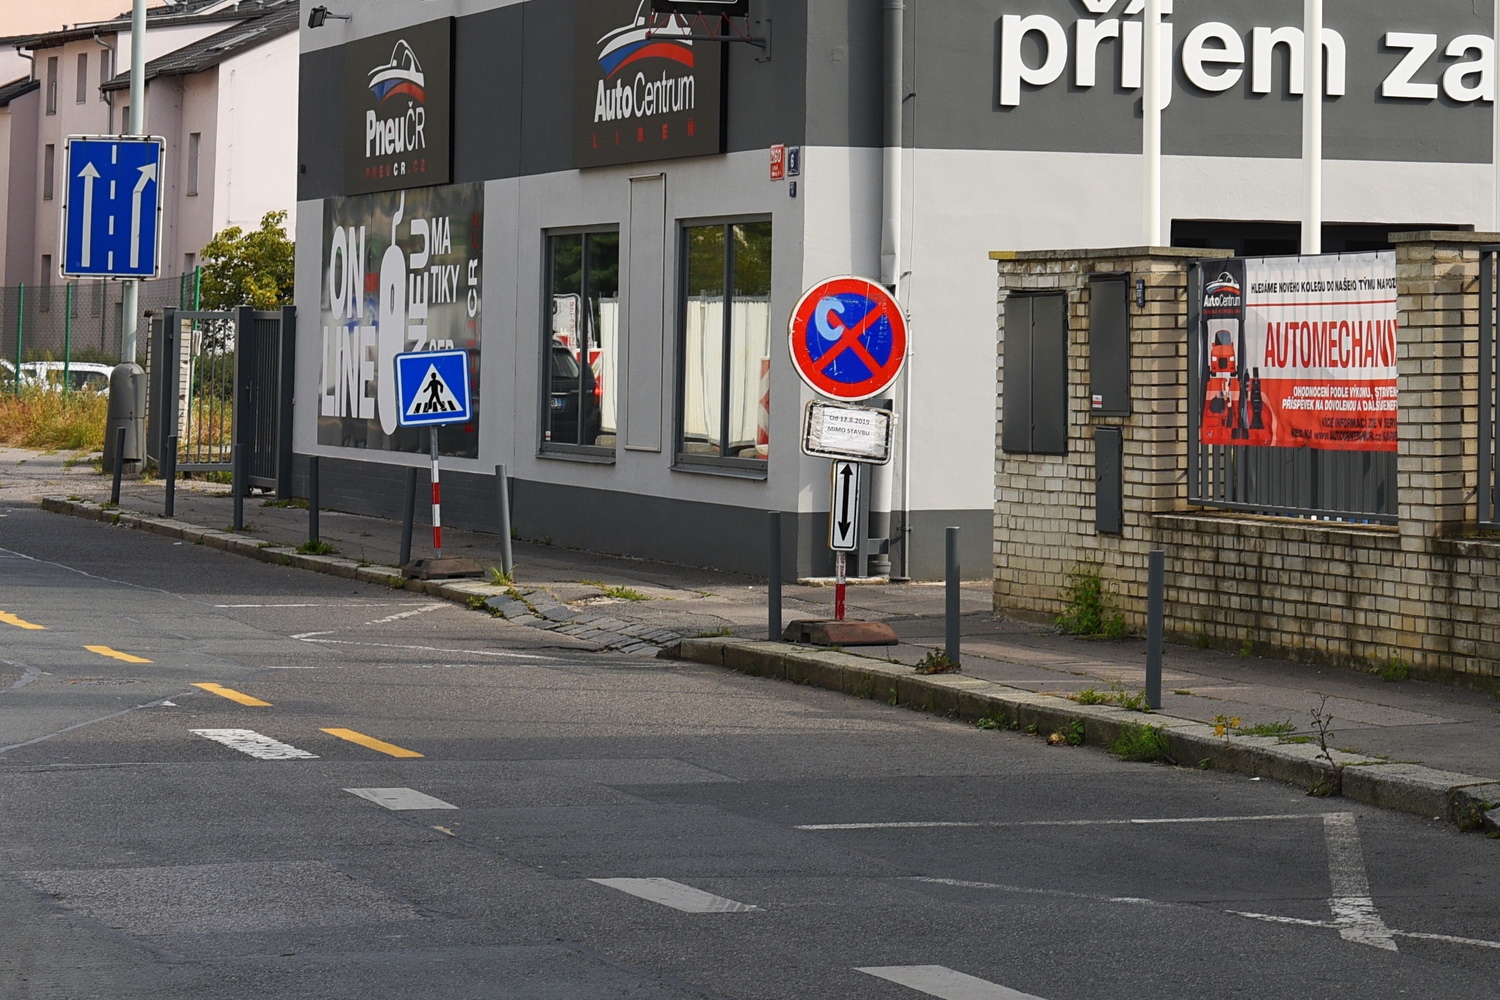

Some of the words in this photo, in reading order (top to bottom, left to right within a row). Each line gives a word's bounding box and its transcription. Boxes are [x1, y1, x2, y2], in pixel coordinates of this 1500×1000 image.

[594, 69, 695, 123] AutoCentrum
[365, 101, 426, 157] PneuČR
[431, 216, 451, 255] MA
[330, 226, 365, 320] ON
[430, 264, 460, 303] TIKY
[1301, 280, 1325, 293] KOLEGU
[321, 325, 376, 419] LINE
